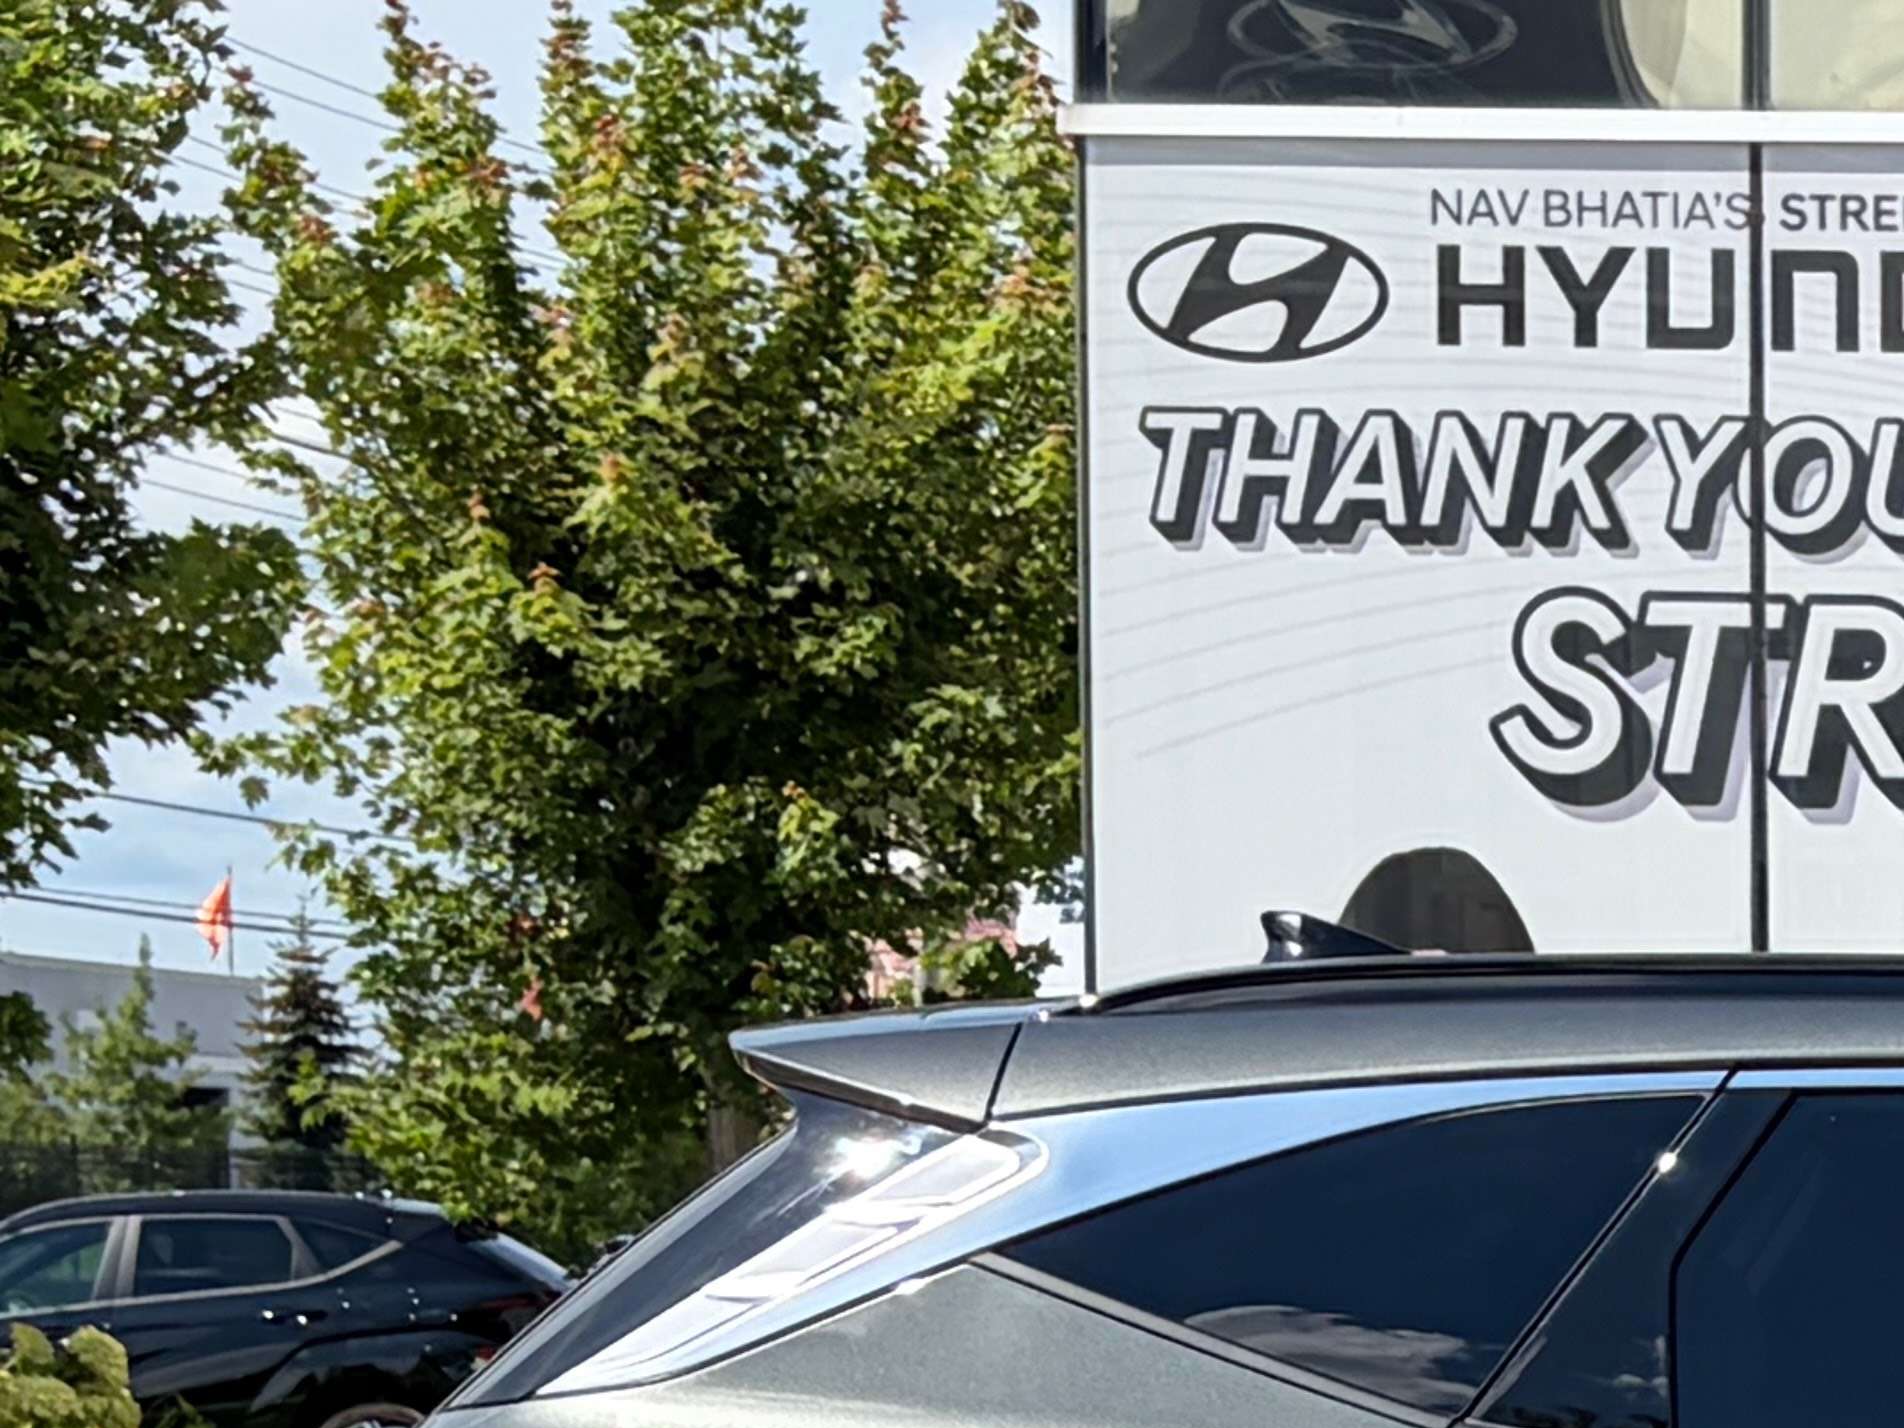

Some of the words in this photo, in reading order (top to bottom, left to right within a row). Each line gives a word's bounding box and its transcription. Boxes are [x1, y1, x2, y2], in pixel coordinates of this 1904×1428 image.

[1430, 187, 1529, 228] NAV
[1543, 189, 1762, 231] BHATIA'S
[1139, 404, 1648, 552] THANK
